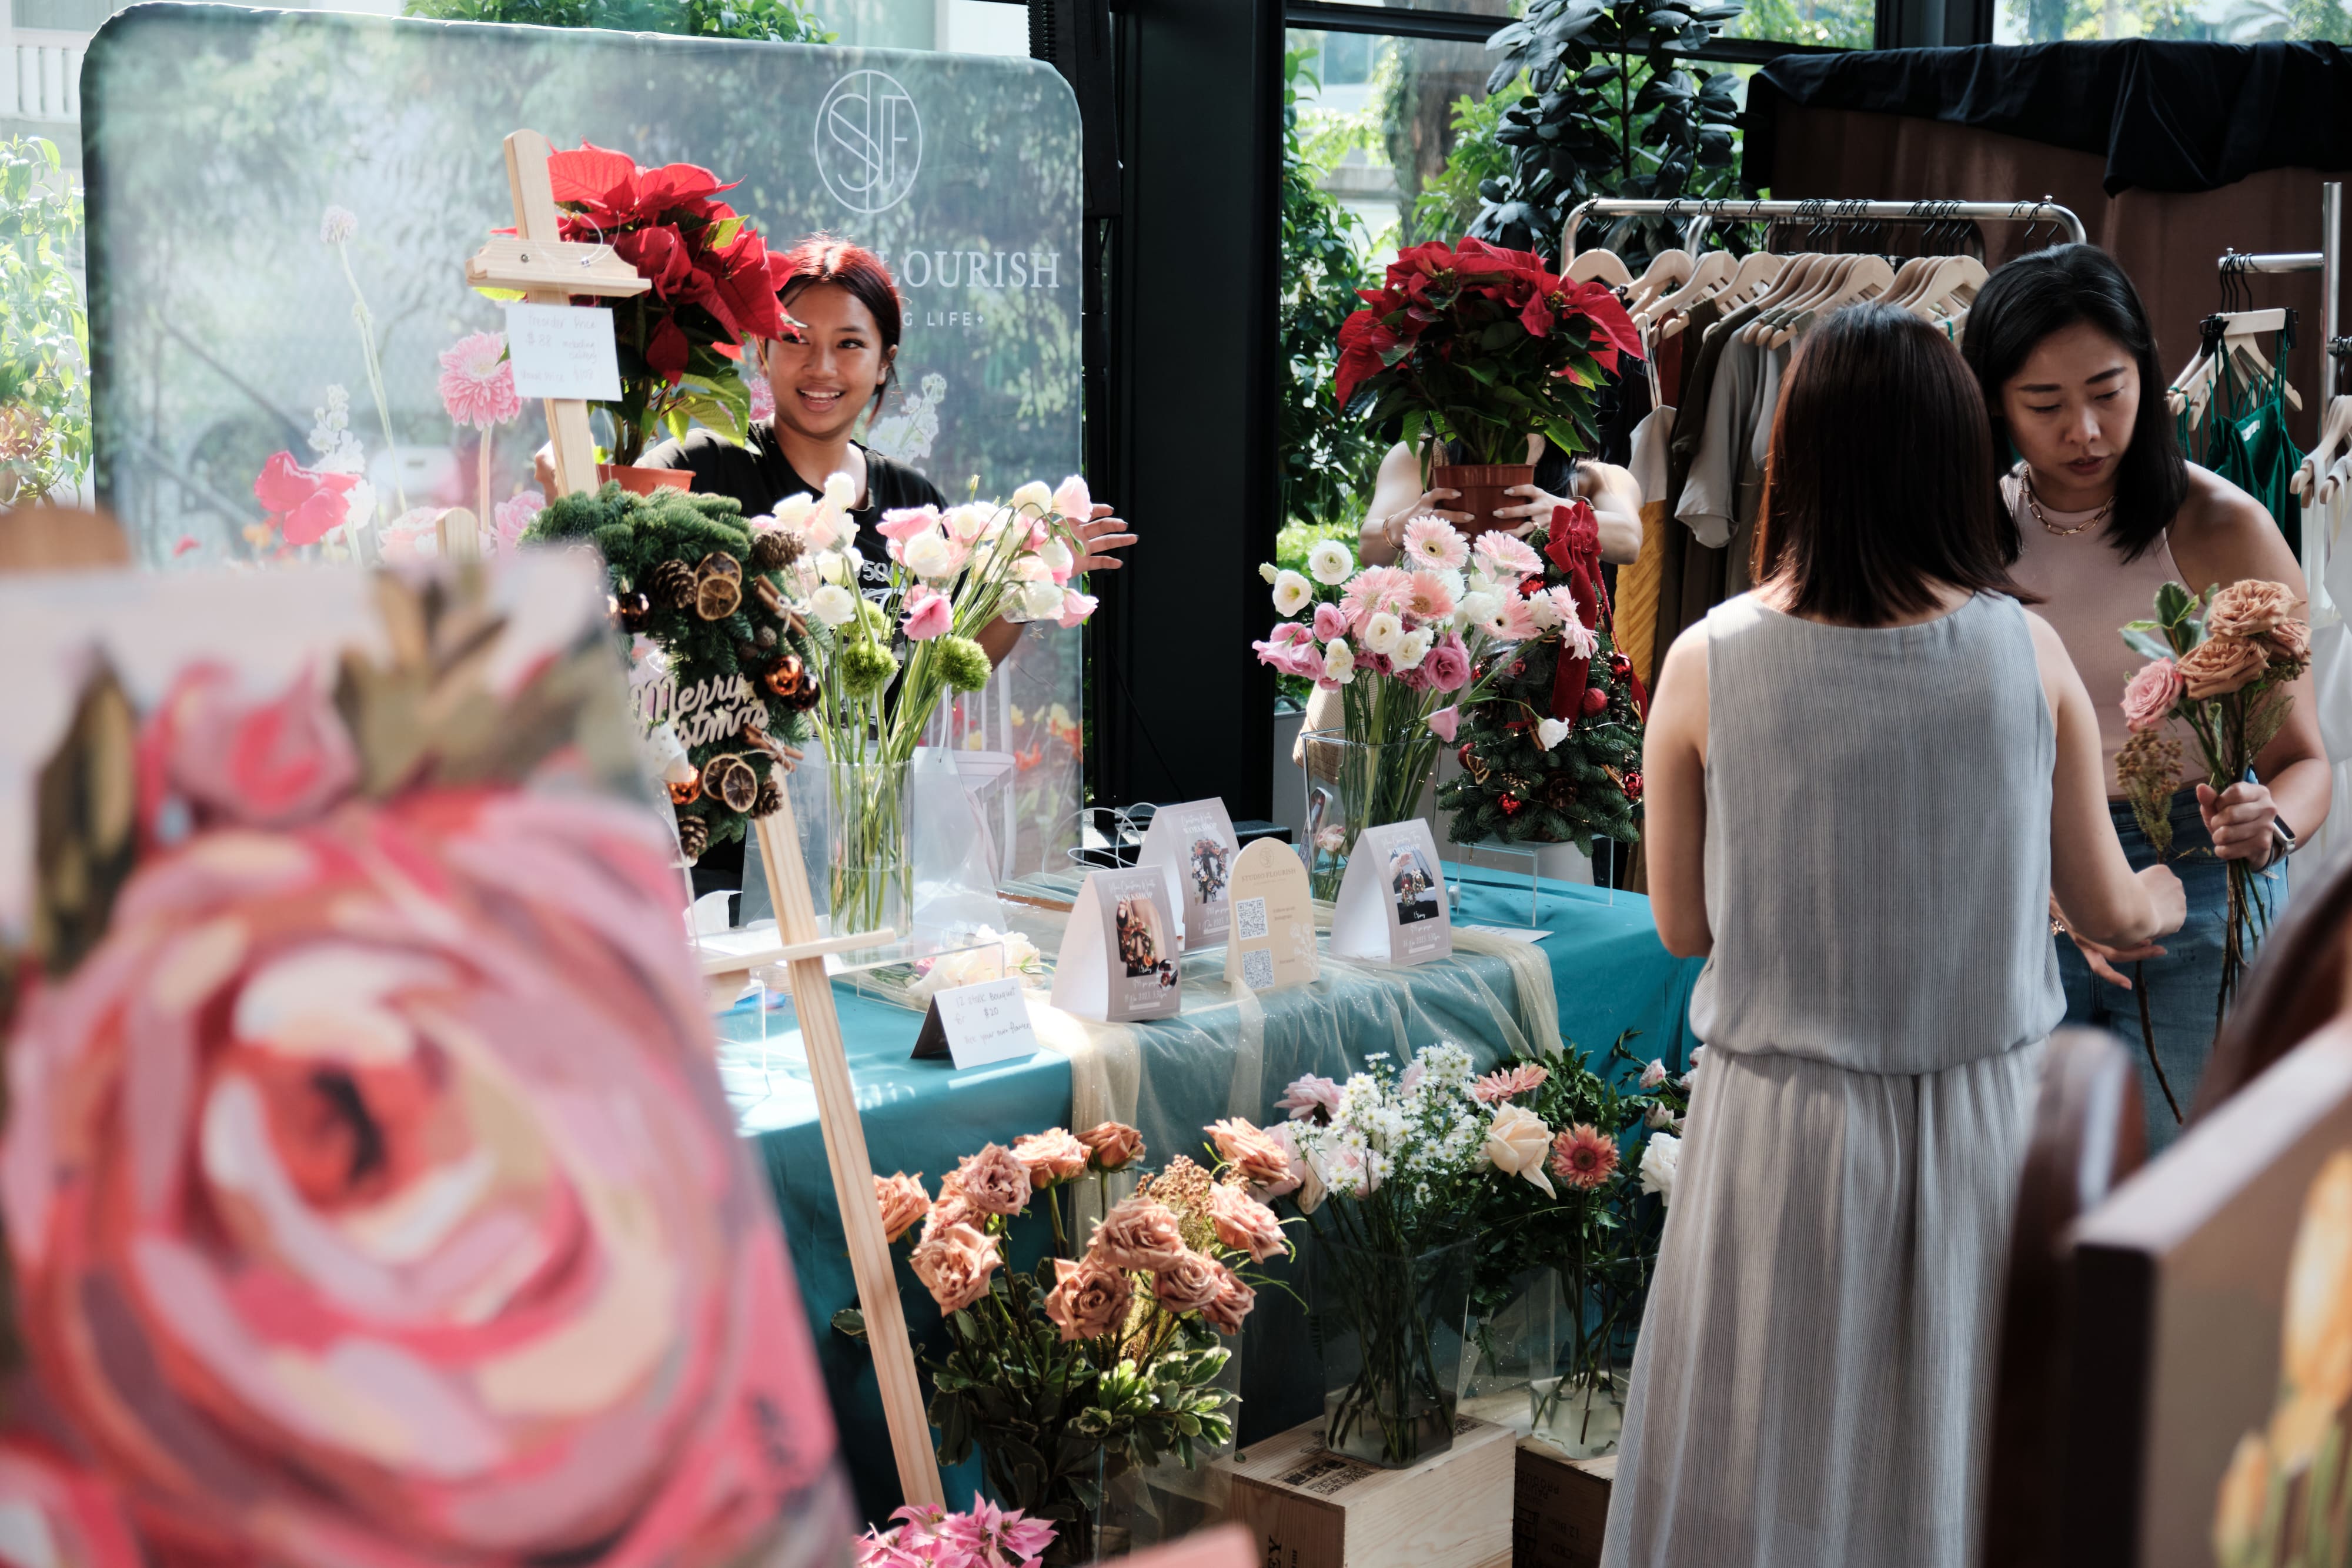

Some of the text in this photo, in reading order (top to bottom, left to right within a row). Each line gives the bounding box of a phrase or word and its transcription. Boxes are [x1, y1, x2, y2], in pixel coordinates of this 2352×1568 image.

[876, 250, 1060, 287] LOURISH
[927, 312, 971, 326] LIFE
[630, 673, 743, 723] Merry
